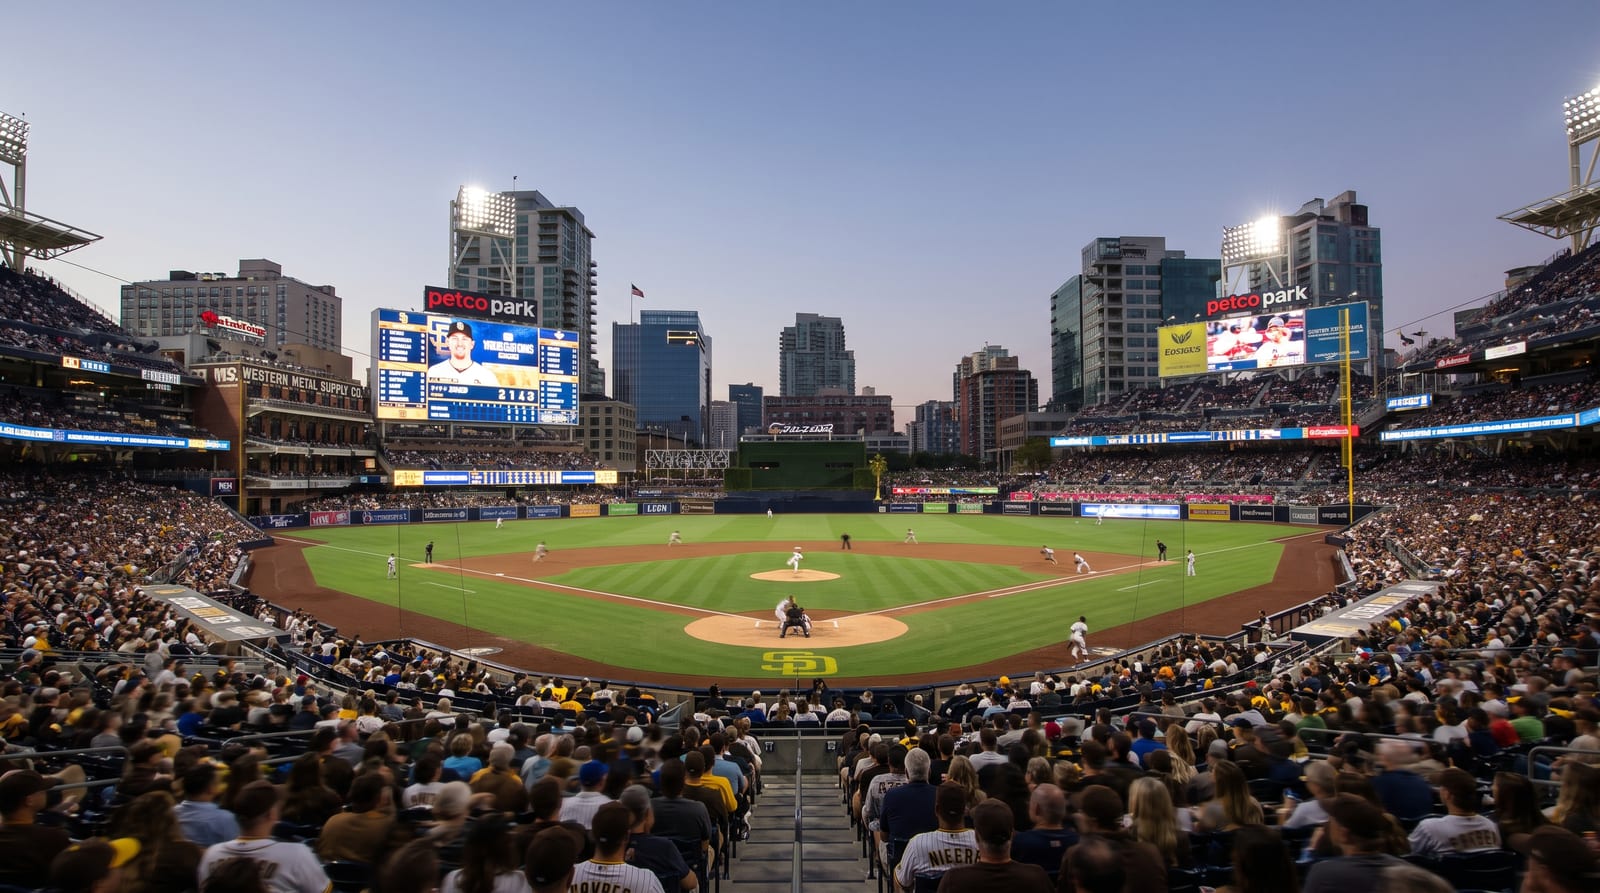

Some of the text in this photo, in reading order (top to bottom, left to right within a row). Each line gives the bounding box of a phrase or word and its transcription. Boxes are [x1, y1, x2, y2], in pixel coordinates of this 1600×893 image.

[428, 290, 536, 318] petco park
[1207, 286, 1308, 316] petco park
[242, 366, 363, 398] WESTERN METAL SUPPLY CO.
